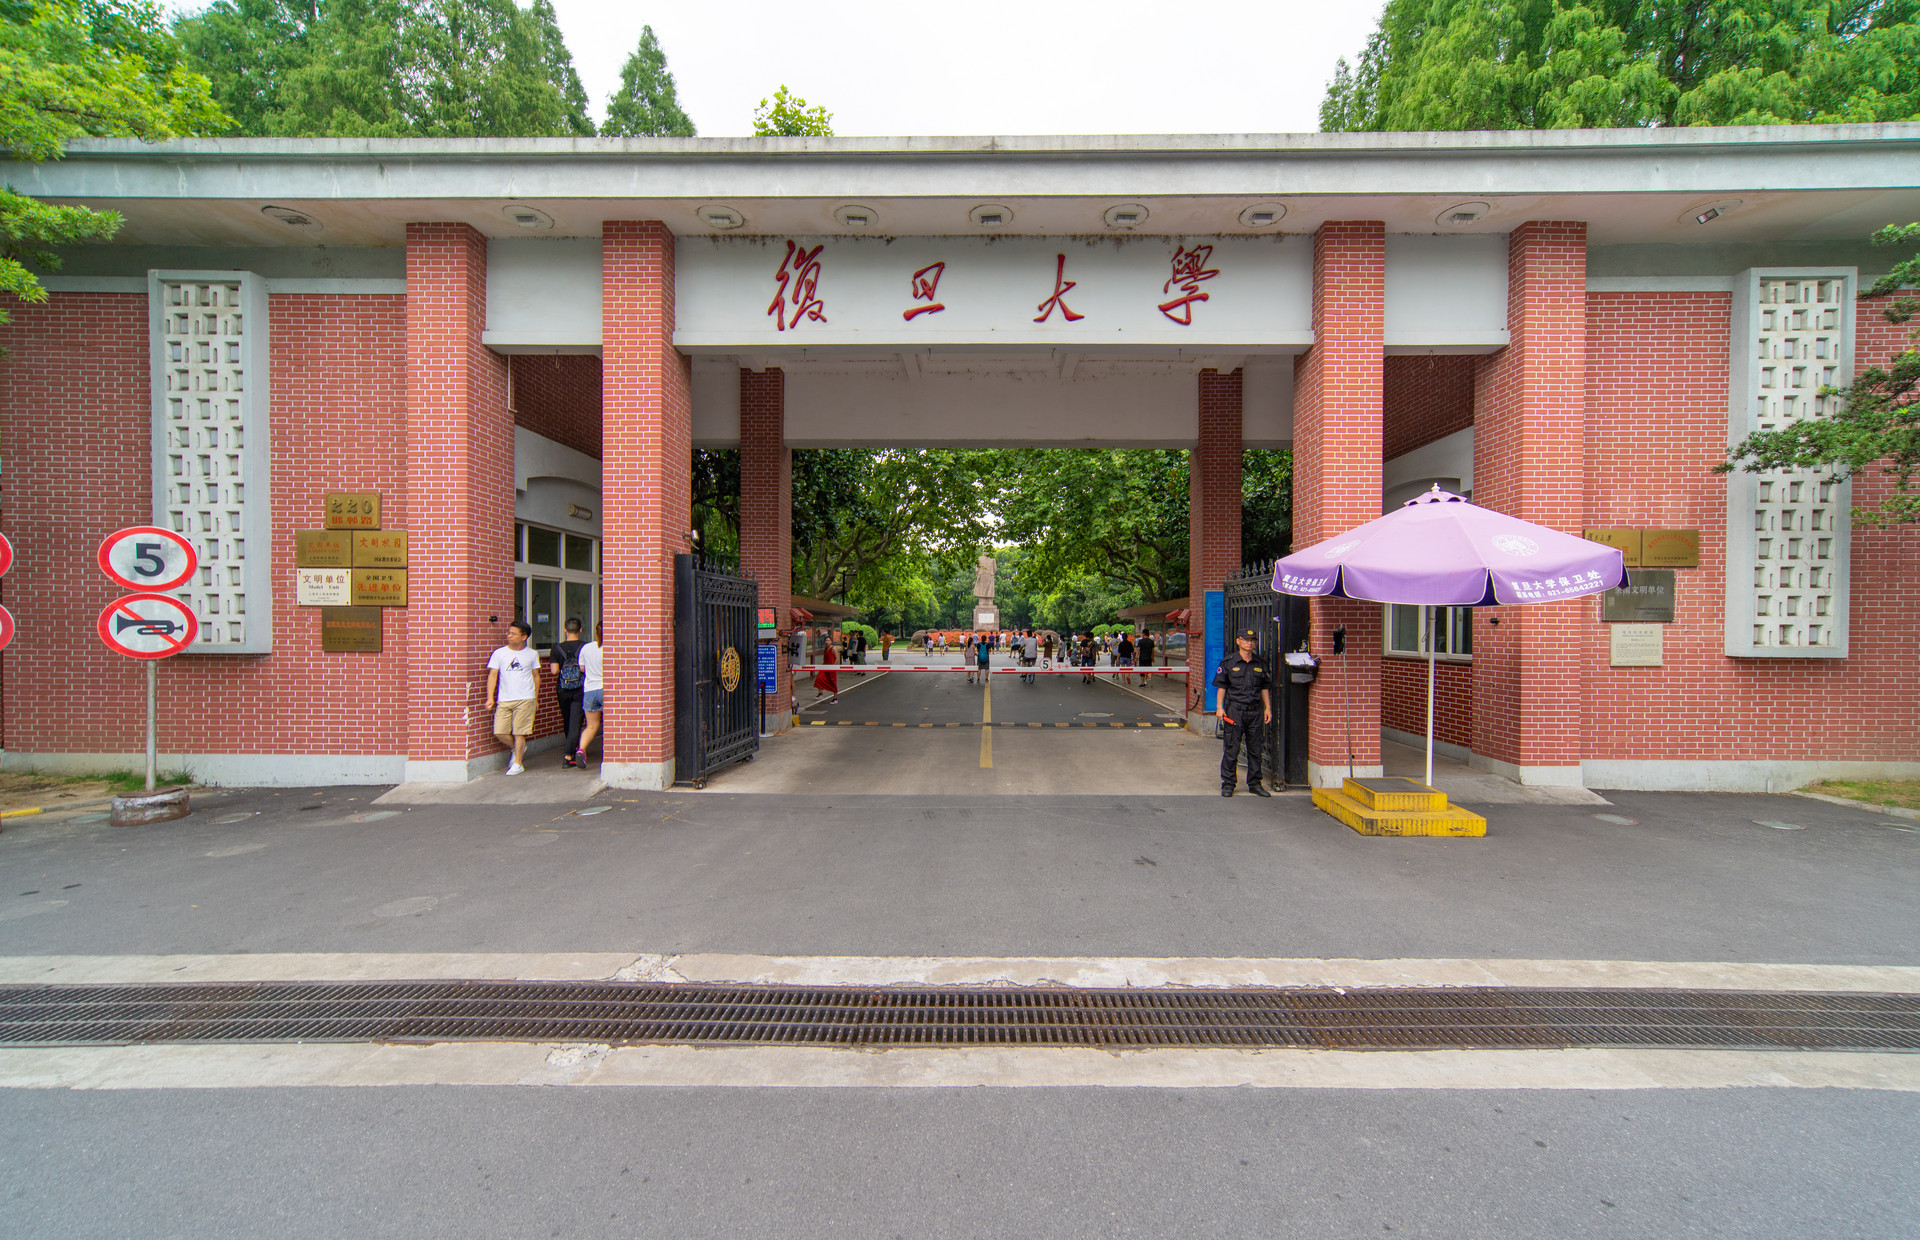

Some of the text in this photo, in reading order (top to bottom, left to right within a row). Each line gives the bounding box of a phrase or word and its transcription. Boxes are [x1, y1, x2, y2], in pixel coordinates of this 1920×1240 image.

[331, 498, 373, 514] 220
[133, 543, 165, 578] 5
[302, 574, 345, 584] 文明单位
[1282, 574, 1329, 587] 复旦大学保卫
[1511, 569, 1602, 591] 复旦大学保卫处
[357, 583, 402, 593] 先进单位
[1043, 660, 1049, 670] 5
